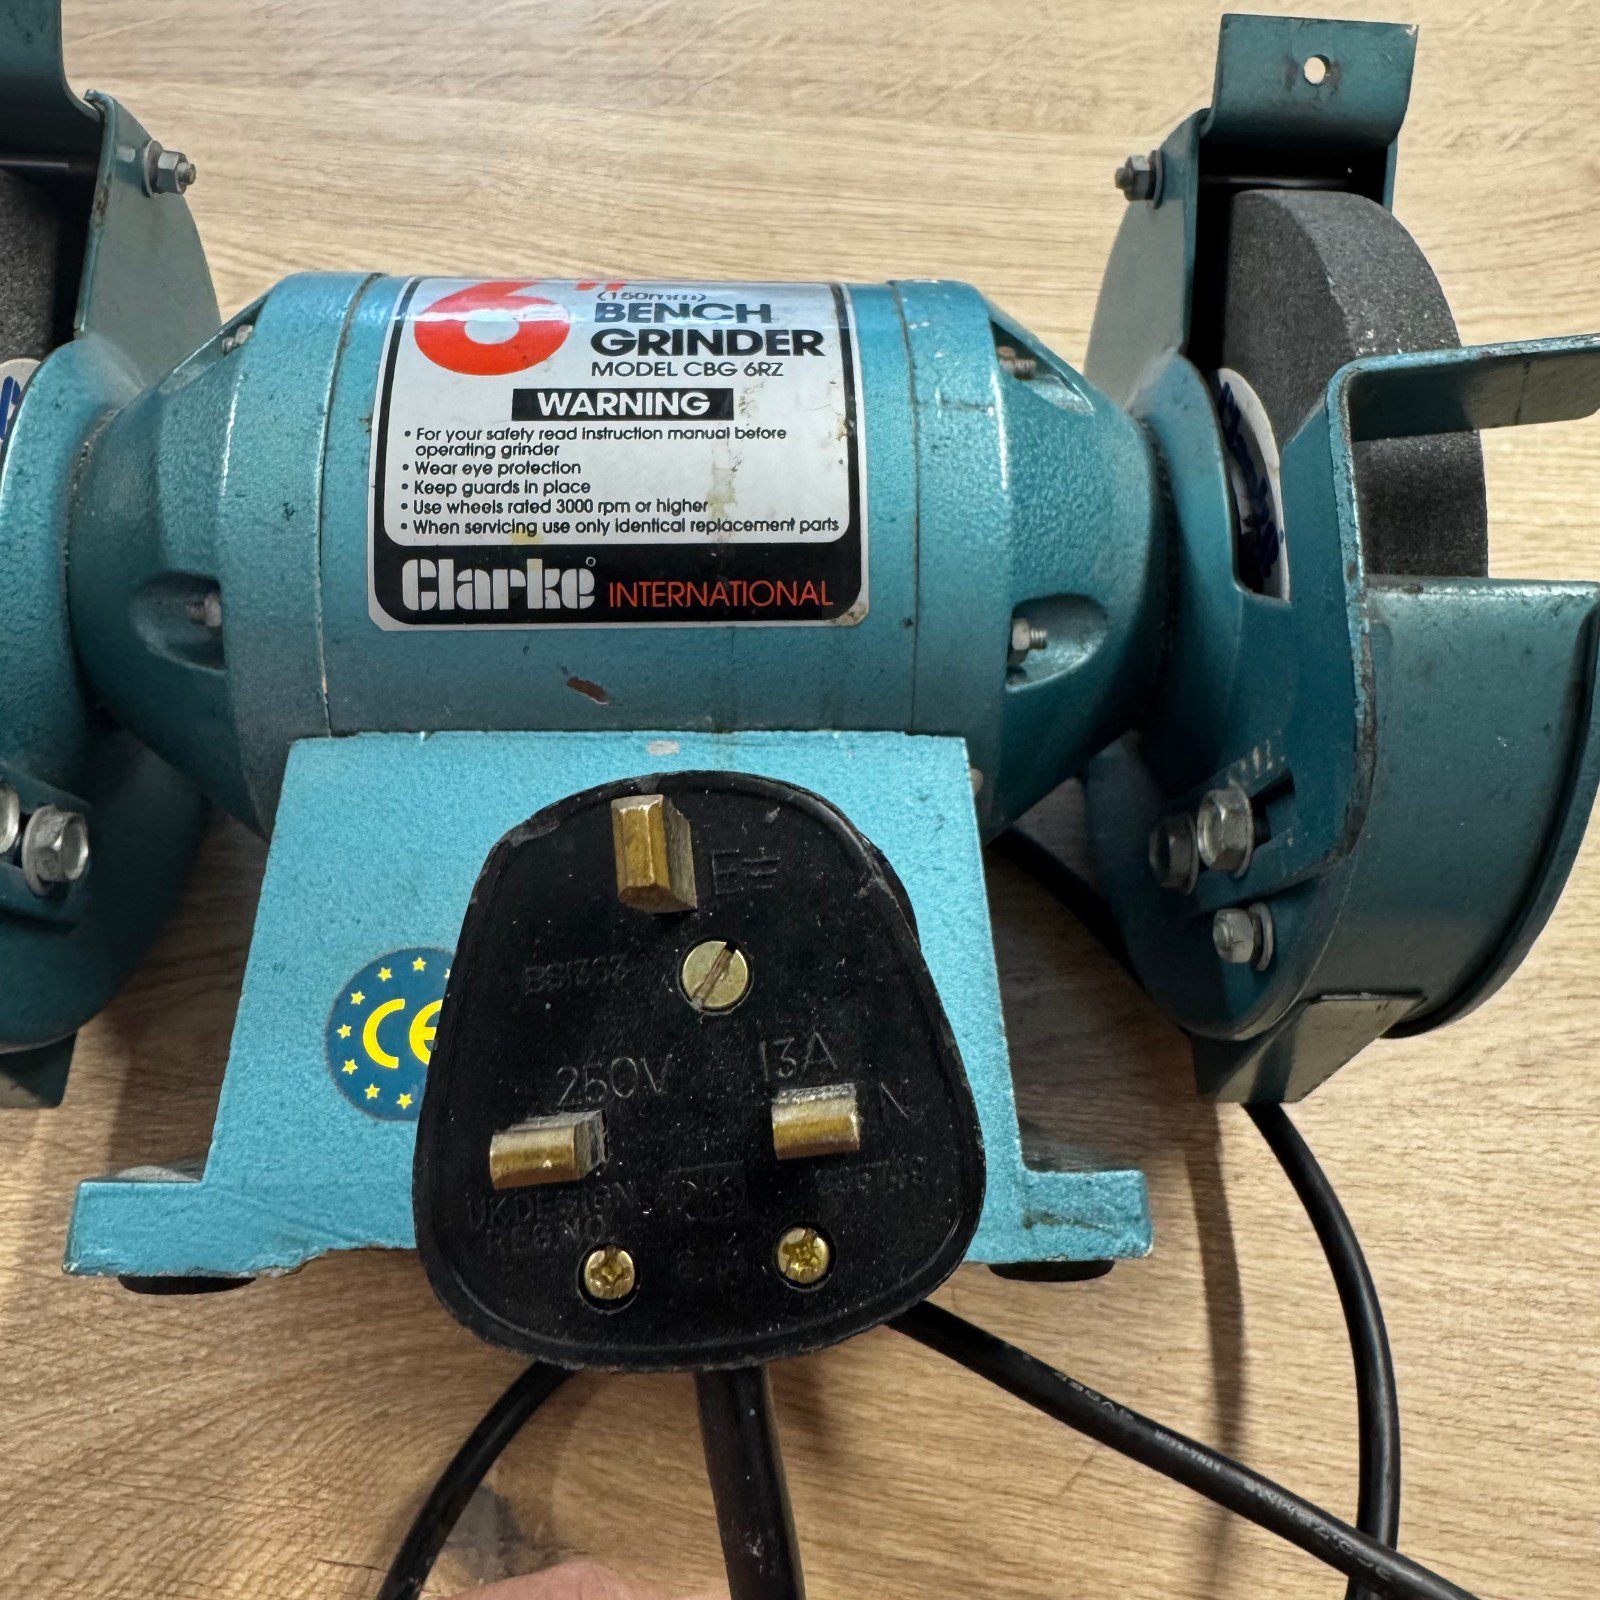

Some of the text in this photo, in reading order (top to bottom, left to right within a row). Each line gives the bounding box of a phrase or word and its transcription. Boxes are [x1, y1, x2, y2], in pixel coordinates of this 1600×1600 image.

[597, 290, 707, 302] (150mm)
[594, 302, 772, 325] BENCH
[590, 328, 825, 357] GRINDER
[591, 361, 784, 377] MODEL CBG 6RZ
[537, 391, 711, 416] WARNING
[416, 427, 787, 443] For your safety read instruction manual before
[415, 442, 560, 459] operating grinder
[414, 460, 581, 478] Wear eye protection
[413, 480, 591, 498] Keep guards in place
[413, 498, 709, 516] Use wheels rated 3000 rpm or higher
[413, 517, 840, 537] When servicing use only identical replacement parts
[401, 558, 596, 611] Clarke
[609, 580, 834, 608] INTERNATIONAL
[758, 1032, 839, 1083] 13A
[556, 1052, 674, 1110] 250V
